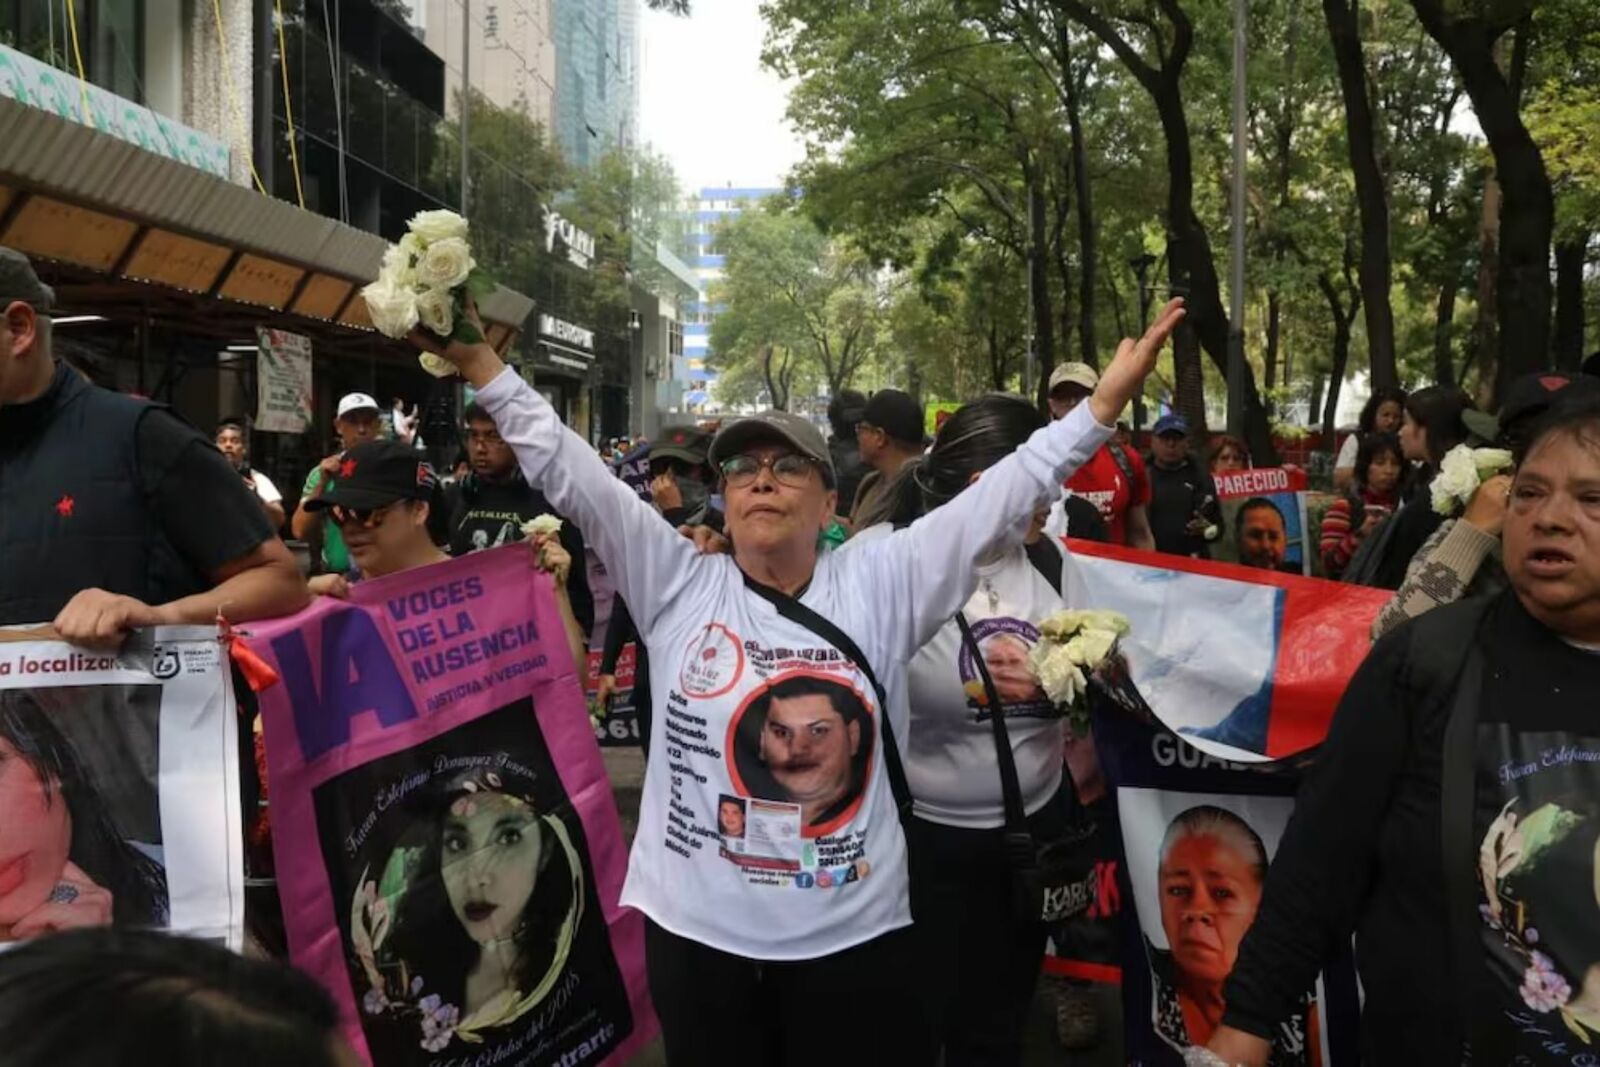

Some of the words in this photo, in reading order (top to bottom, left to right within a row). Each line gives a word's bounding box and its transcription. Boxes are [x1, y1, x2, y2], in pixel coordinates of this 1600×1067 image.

[387, 576, 484, 622] VOCES
[397, 622, 437, 654] DE
[438, 611, 476, 640] LA
[411, 619, 539, 684] AUSENCIA
[483, 674, 495, 687] Y
[494, 654, 548, 682] VERDAD
